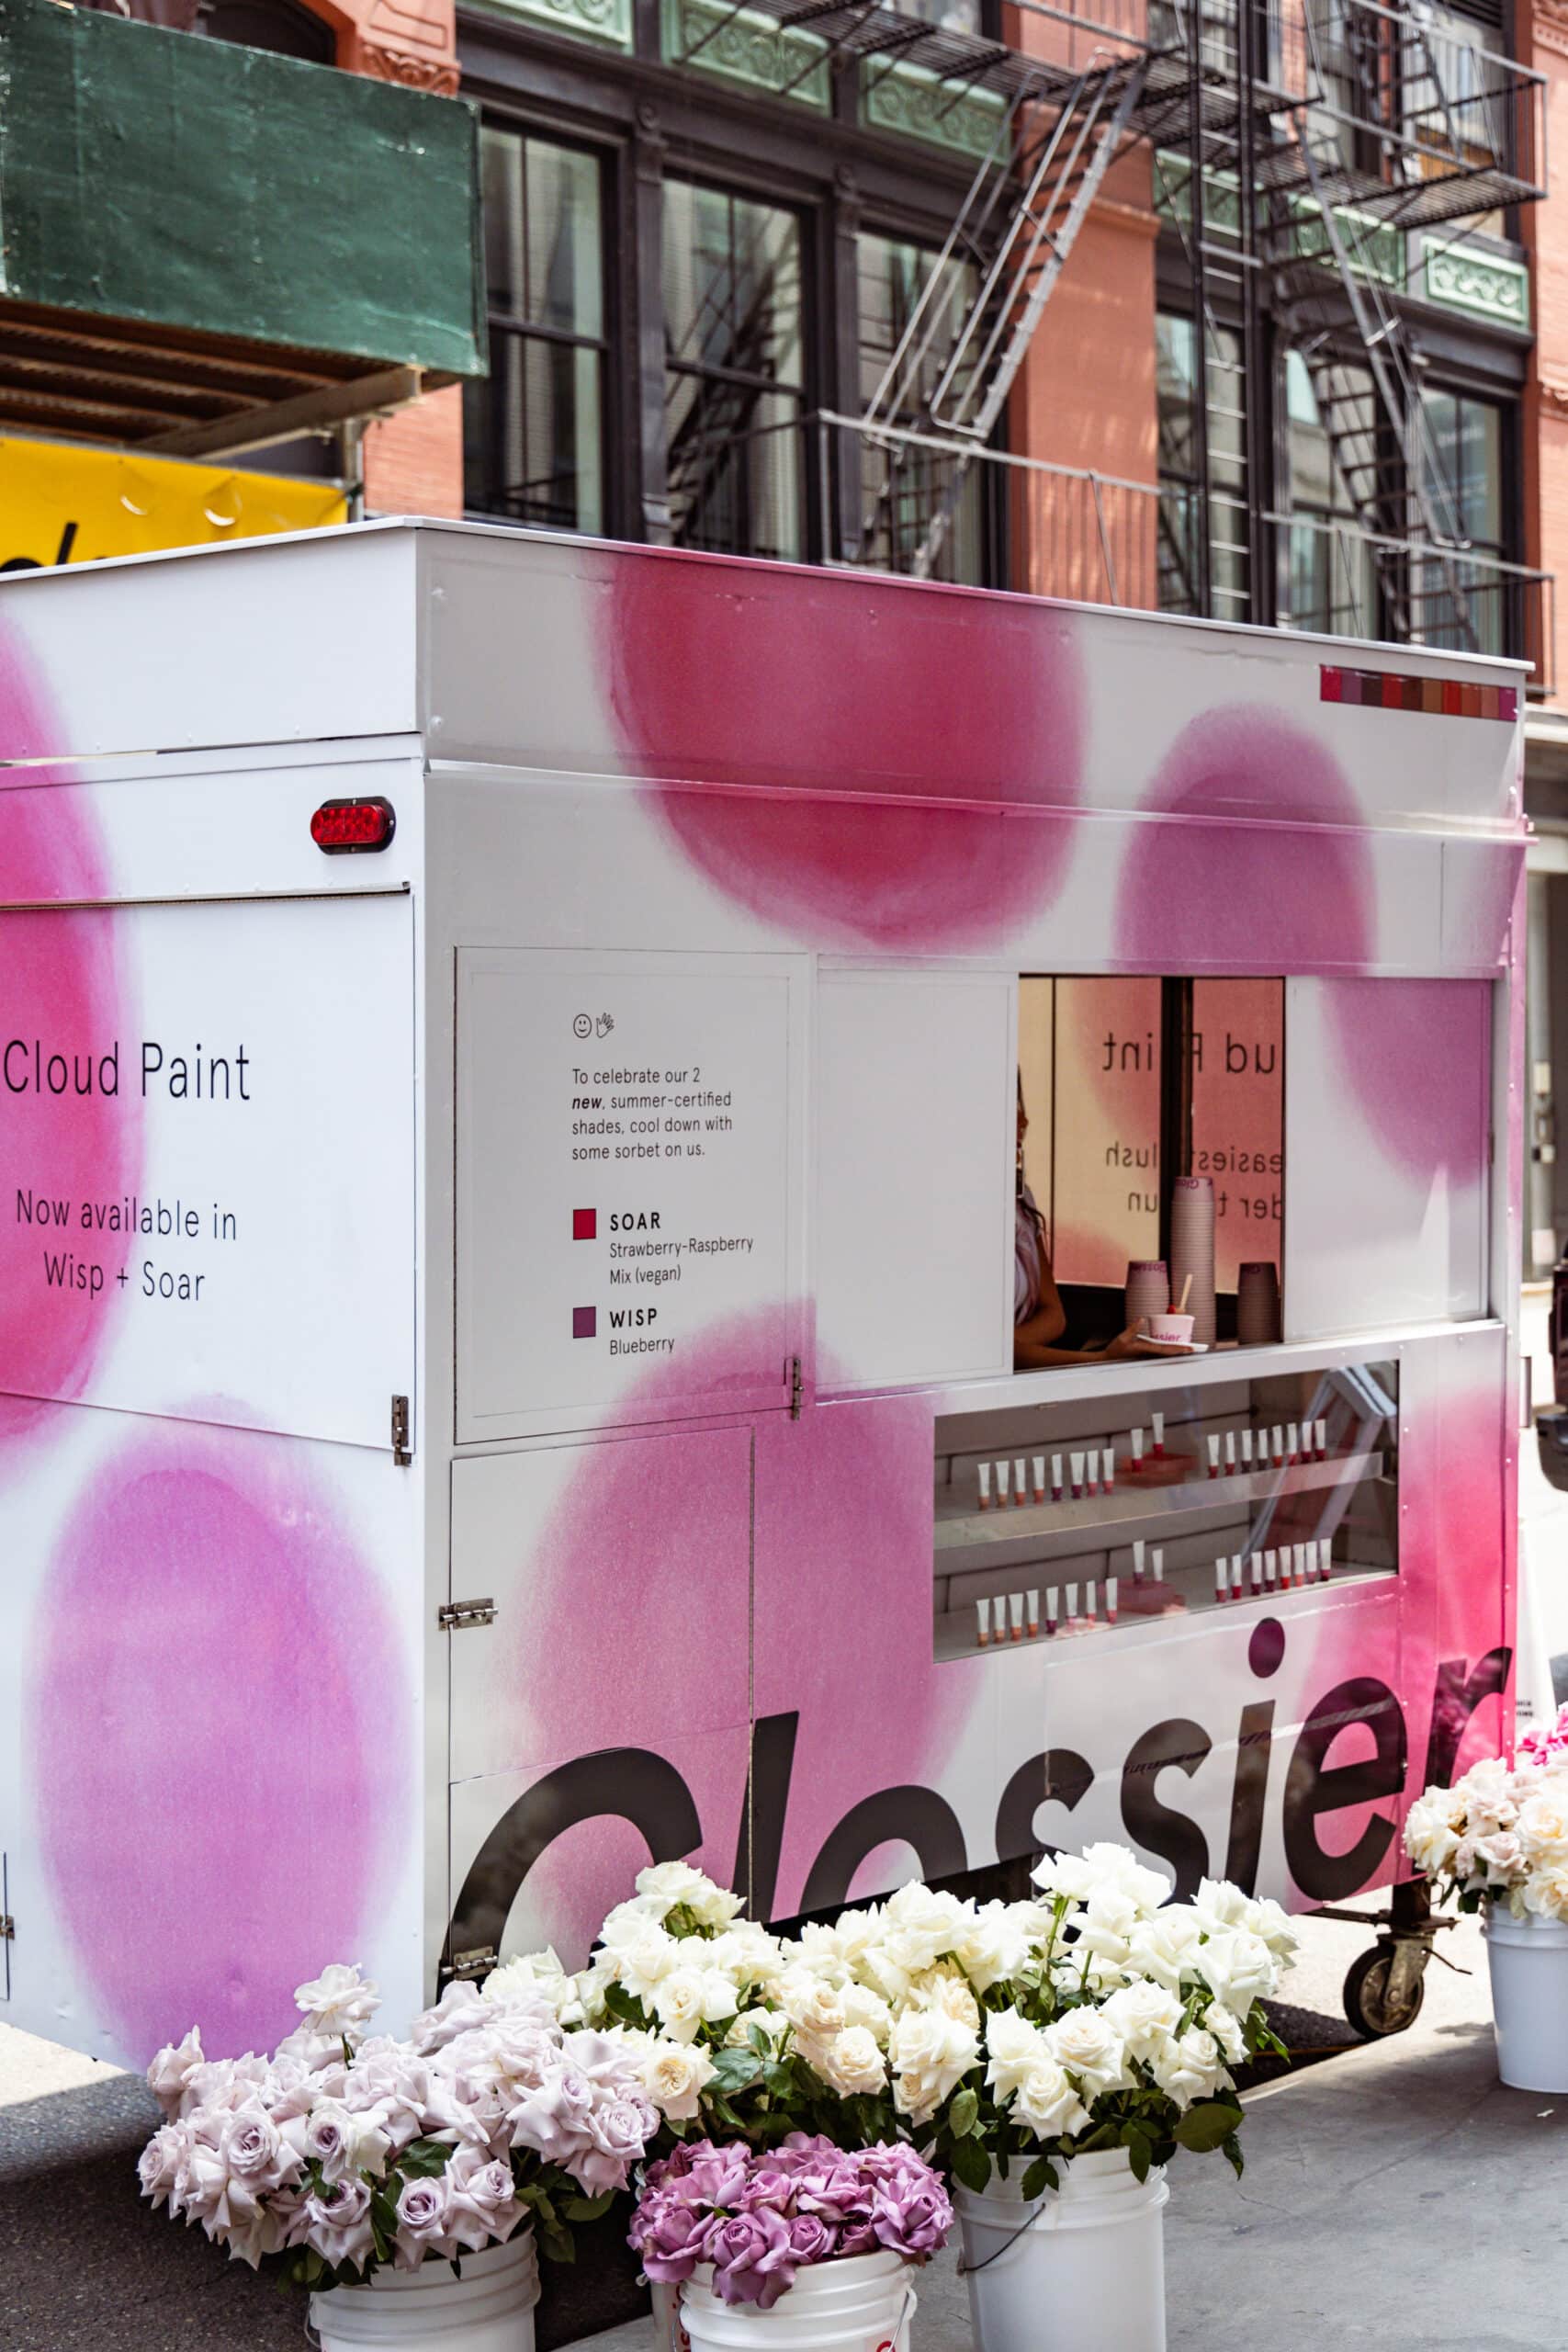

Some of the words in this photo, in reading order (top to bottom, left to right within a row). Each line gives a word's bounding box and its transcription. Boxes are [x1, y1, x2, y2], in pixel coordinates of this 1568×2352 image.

[3, 1039, 118, 1097] Cloud
[141, 1042, 251, 1101] Paint
[572, 1068, 589, 1085] To
[593, 1068, 660, 1085] celebrate
[665, 1070, 689, 1084] our
[692, 1067, 701, 1083] 2
[571, 1097, 605, 1110] new,
[611, 1091, 732, 1110] summer-certified
[572, 1118, 626, 1136] shades,
[629, 1116, 660, 1134] cool
[664, 1116, 701, 1133] down
[705, 1114, 733, 1132] with
[572, 1147, 611, 1161] some
[615, 1142, 660, 1159] sorbet
[664, 1144, 682, 1158] on
[686, 1143, 705, 1157] us.
[17, 1188, 71, 1227] Now
[80, 1196, 199, 1238] available
[213, 1203, 236, 1240] in
[609, 1211, 661, 1232] SOAR
[609, 1236, 754, 1259] Strawberry-Raspberry
[43, 1250, 104, 1301] Wisp
[116, 1267, 130, 1289] +
[142, 1261, 206, 1302] Soar
[610, 1268, 632, 1285] Mix
[635, 1263, 682, 1286] (vegan)
[609, 1307, 658, 1329] WISP
[609, 1337, 675, 1356] Blueberry
